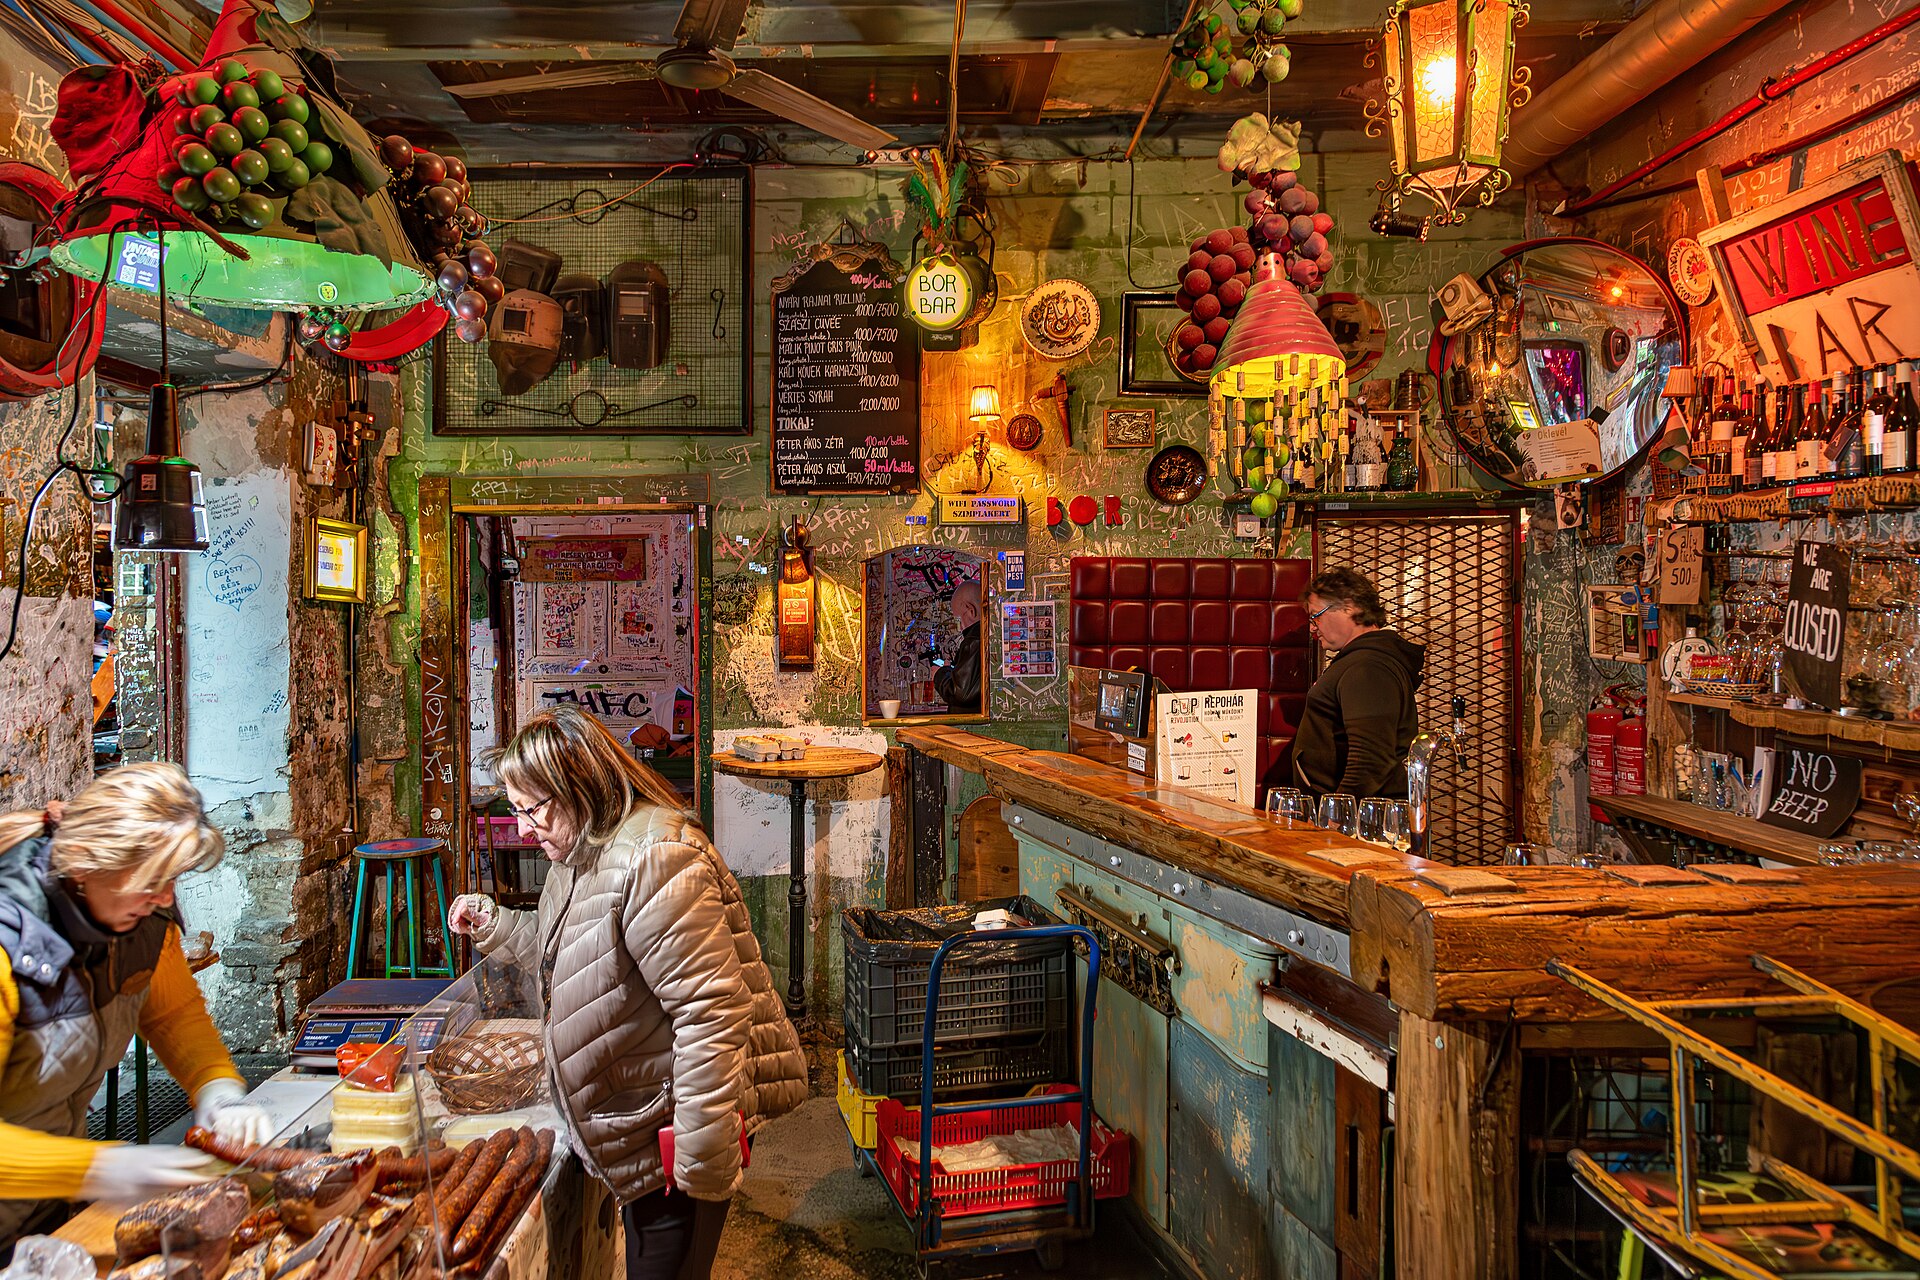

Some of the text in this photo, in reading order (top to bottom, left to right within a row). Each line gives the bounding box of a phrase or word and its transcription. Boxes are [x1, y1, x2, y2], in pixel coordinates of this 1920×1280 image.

[126, 240, 160, 259] VINTAG
[1736, 186, 1905, 298] WINE
[919, 274, 957, 293] BOR
[834, 292, 866, 305] RIZLING
[920, 297, 957, 314] BAR
[855, 303, 899, 317] 1000/7500
[854, 327, 898, 342] 1000/7500
[804, 342, 825, 354] PINOT
[827, 341, 843, 353] GRIS
[845, 340, 863, 353] PINK
[851, 350, 893, 364] 1100/8200
[859, 374, 900, 388] 1100/8200
[809, 390, 834, 403] SYRAH
[859, 397, 900, 411] 1200/9000
[777, 417, 814, 430] TOKAJ:
[1537, 426, 1568, 440] Oklevél
[776, 437, 802, 450] PÉTER
[825, 435, 844, 449] ZÉTA
[849, 446, 888, 460] 1100/8200
[777, 462, 801, 476] PÉTER
[846, 472, 892, 486] 1750/17500
[953, 510, 1011, 518] SZIMPLAKERT
[1046, 494, 1123, 526] BOR
[1802, 544, 1820, 567] WE
[213, 564, 243, 579] BEASTY
[1007, 572, 1023, 580] PEST
[1670, 567, 1691, 586] 500
[1809, 568, 1832, 591] ARE
[1784, 600, 1841, 662] CLOSED
[1204, 694, 1244, 709] REPOHÁR
[1787, 750, 1837, 793] NO
[1769, 788, 1829, 824] BEER
